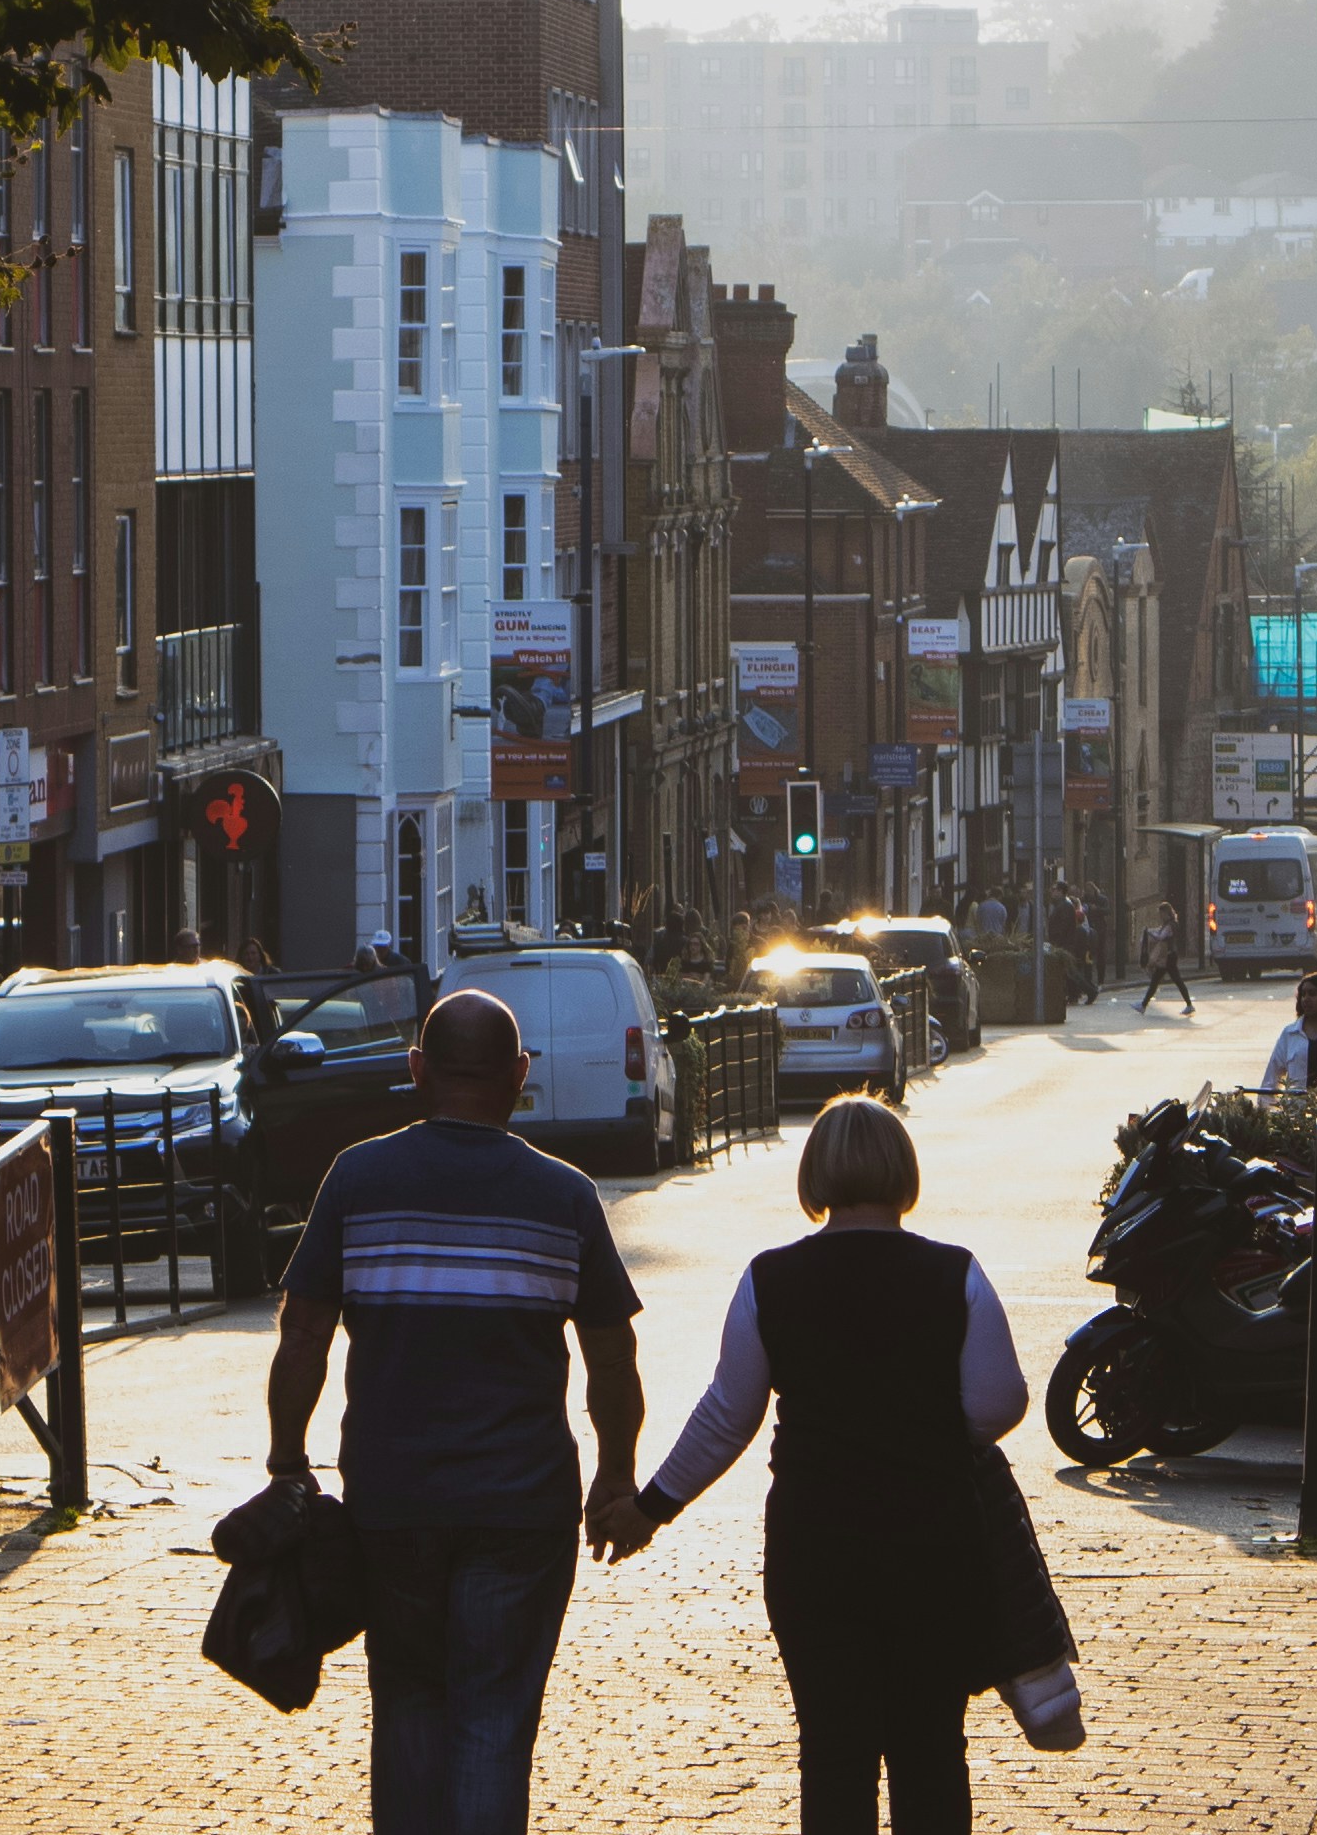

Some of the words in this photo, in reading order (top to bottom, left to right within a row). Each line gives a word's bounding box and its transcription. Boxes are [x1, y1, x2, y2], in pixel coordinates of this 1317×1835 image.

[494, 619, 529, 631] GUM
[518, 653, 553, 663] Watch
[555, 653, 567, 663] it!
[747, 663, 795, 672] FLINGER
[28, 776, 46, 805] an
[5, 1171, 39, 1244] ROAD
[1, 1237, 49, 1323] CLOSED
